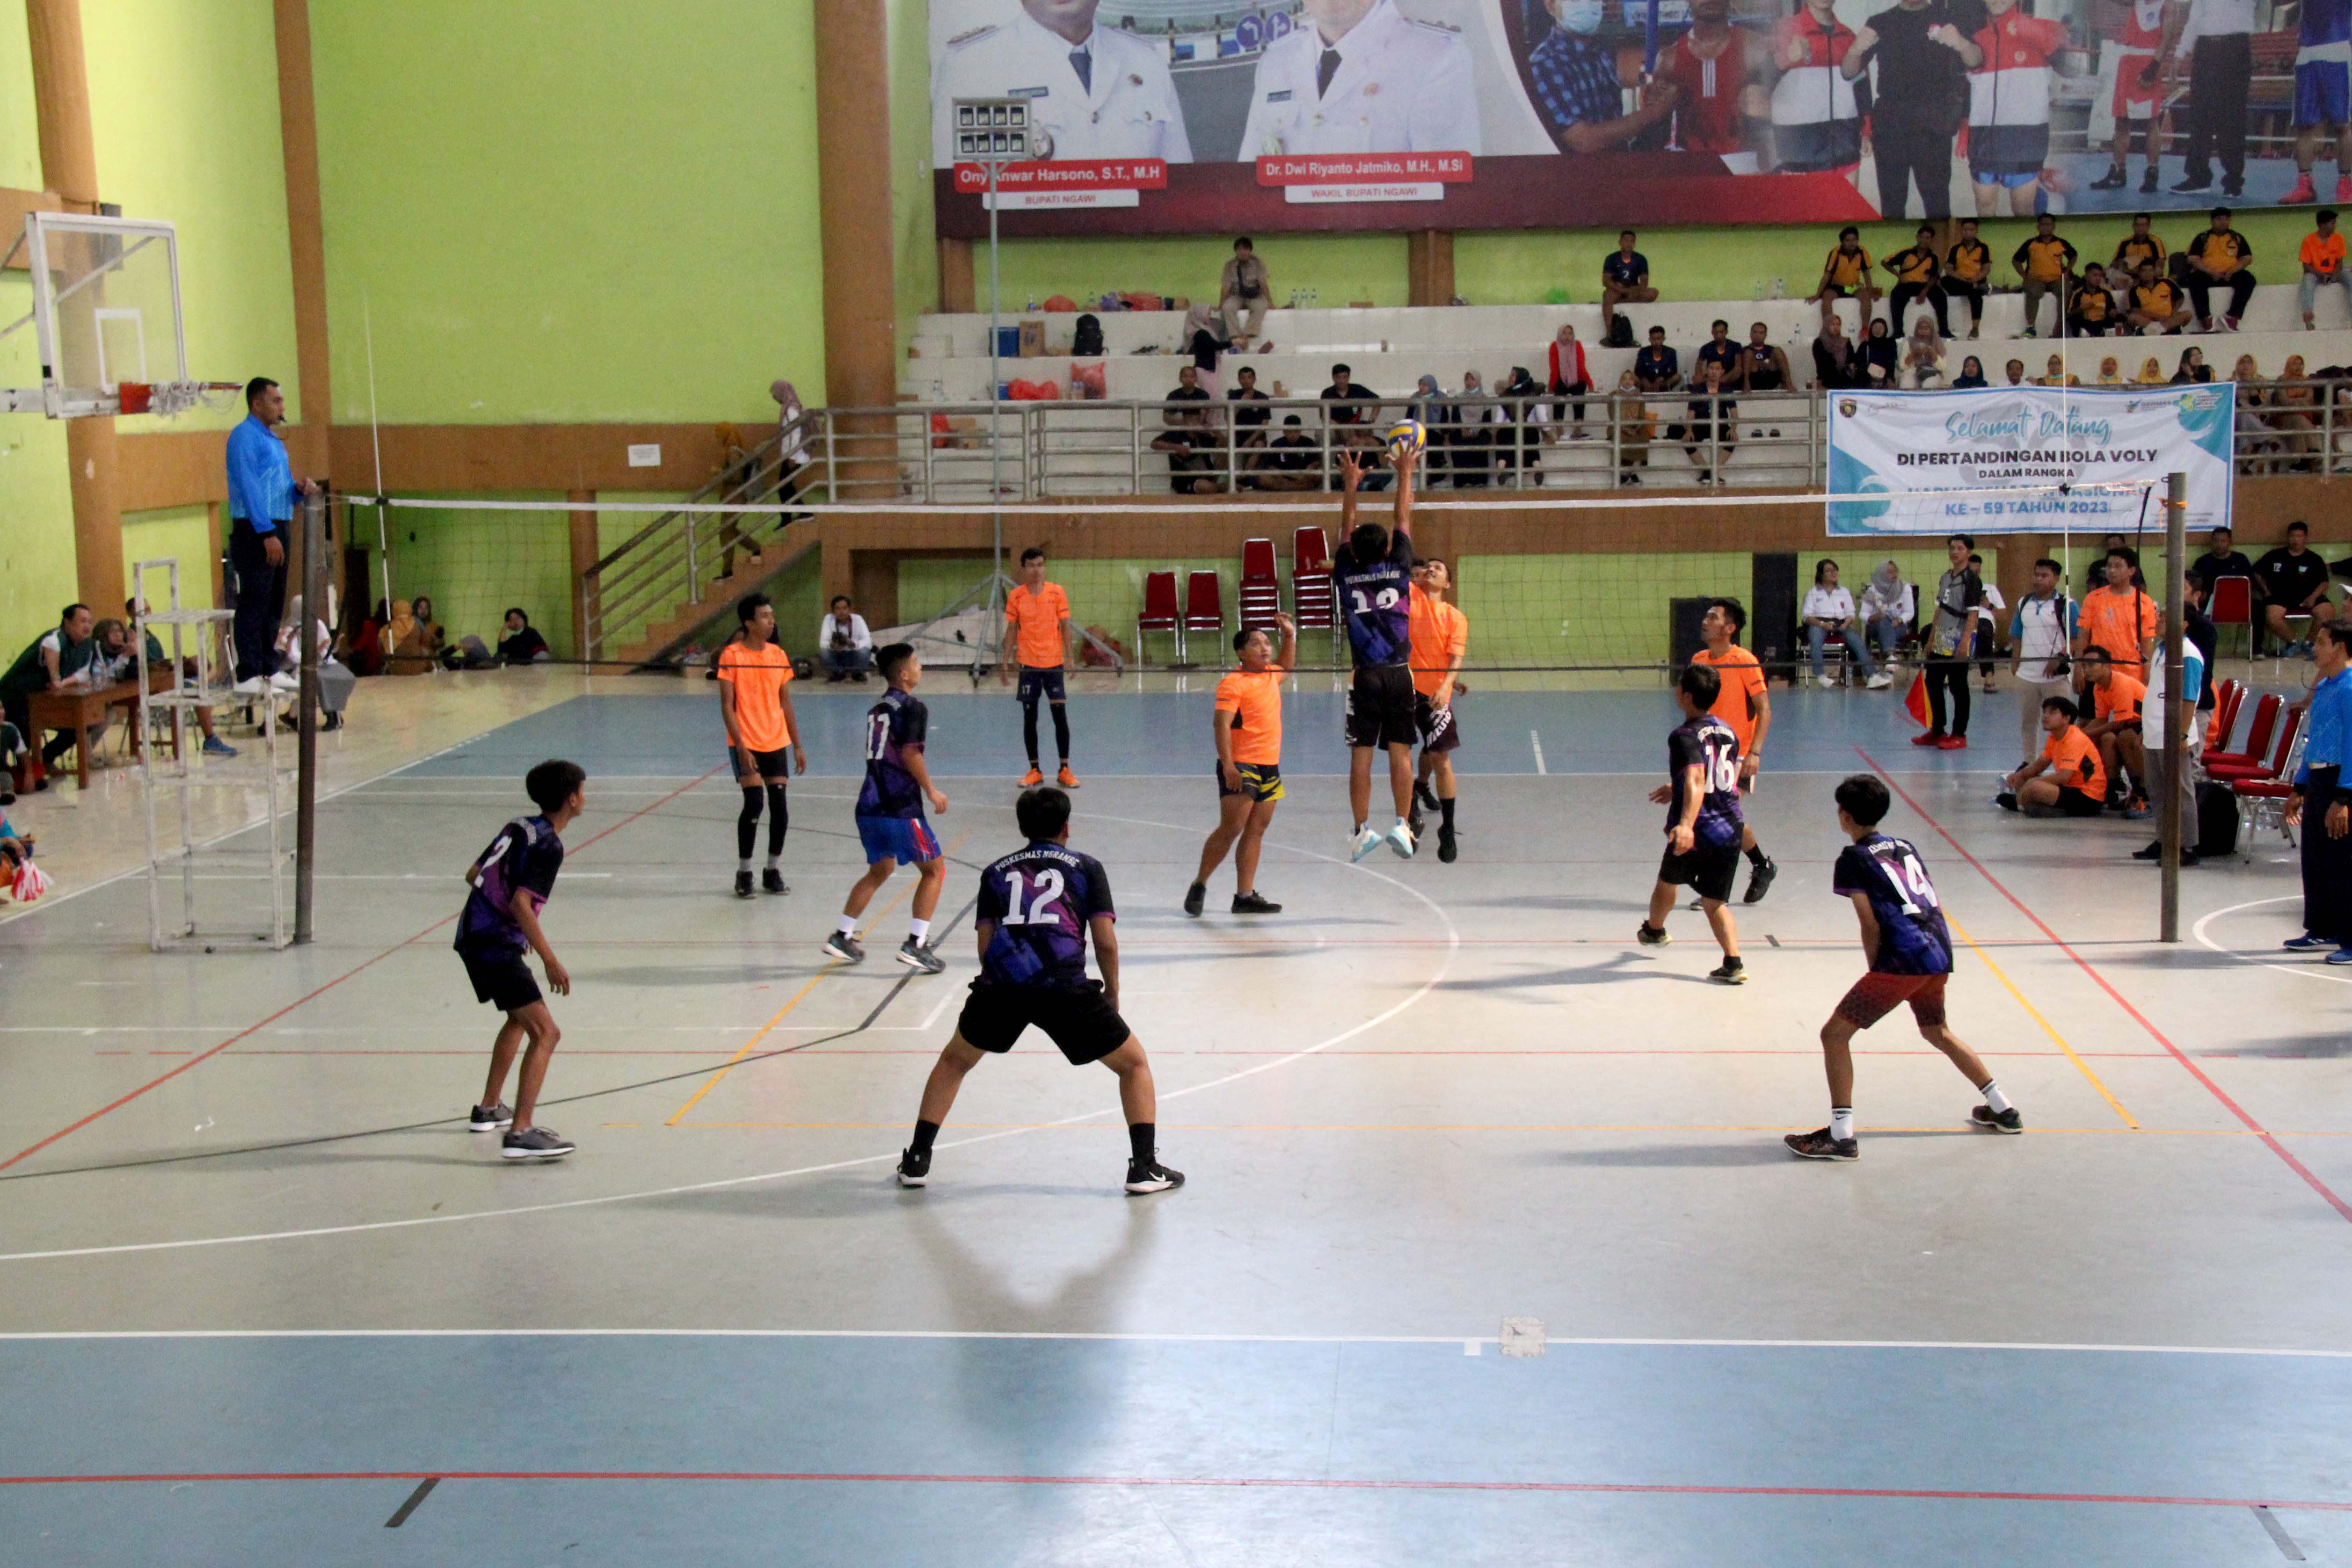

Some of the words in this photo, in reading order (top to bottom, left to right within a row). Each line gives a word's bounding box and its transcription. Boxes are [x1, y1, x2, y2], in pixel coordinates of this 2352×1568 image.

[961, 170, 987, 185] Ony
[1037, 168, 1098, 181] Harsono,
[1102, 167, 1130, 180] S.T.,
[1134, 166, 1160, 179] M.H
[1266, 163, 1282, 175] Dr.
[1285, 162, 1306, 174] Dwi
[1310, 162, 1353, 177] Riyanto
[1356, 161, 1404, 174] Jatmiko,
[1407, 160, 1435, 173] M.H.,
[1439, 159, 1463, 171] M.Si
[1025, 196, 1060, 204] BUPATI
[1063, 195, 1096, 204] NGAWI
[1311, 189, 1343, 198] WAKIL
[1346, 189, 1381, 197] BUPATI
[1384, 188, 1417, 196] NGAWI
[1945, 405, 2032, 444] Selamat
[2039, 405, 2111, 445] Datang
[1897, 454, 1914, 465] DI
[1918, 450, 2056, 465] PERTANDINGAN
[2060, 450, 2105, 462] BOLA
[2110, 450, 2157, 462] VOLY
[1979, 469, 2022, 478] DALAM
[2025, 468, 2074, 477] RANGKA
[1945, 503, 1966, 515] KE
[1983, 501, 2003, 514] 59
[2007, 501, 2065, 514] TAHUN
[2068, 501, 2108, 513] 2023
[995, 850, 1041, 872] PUSKESMAS
[1880, 854, 1938, 915] 14
[1002, 868, 1064, 926] 12
